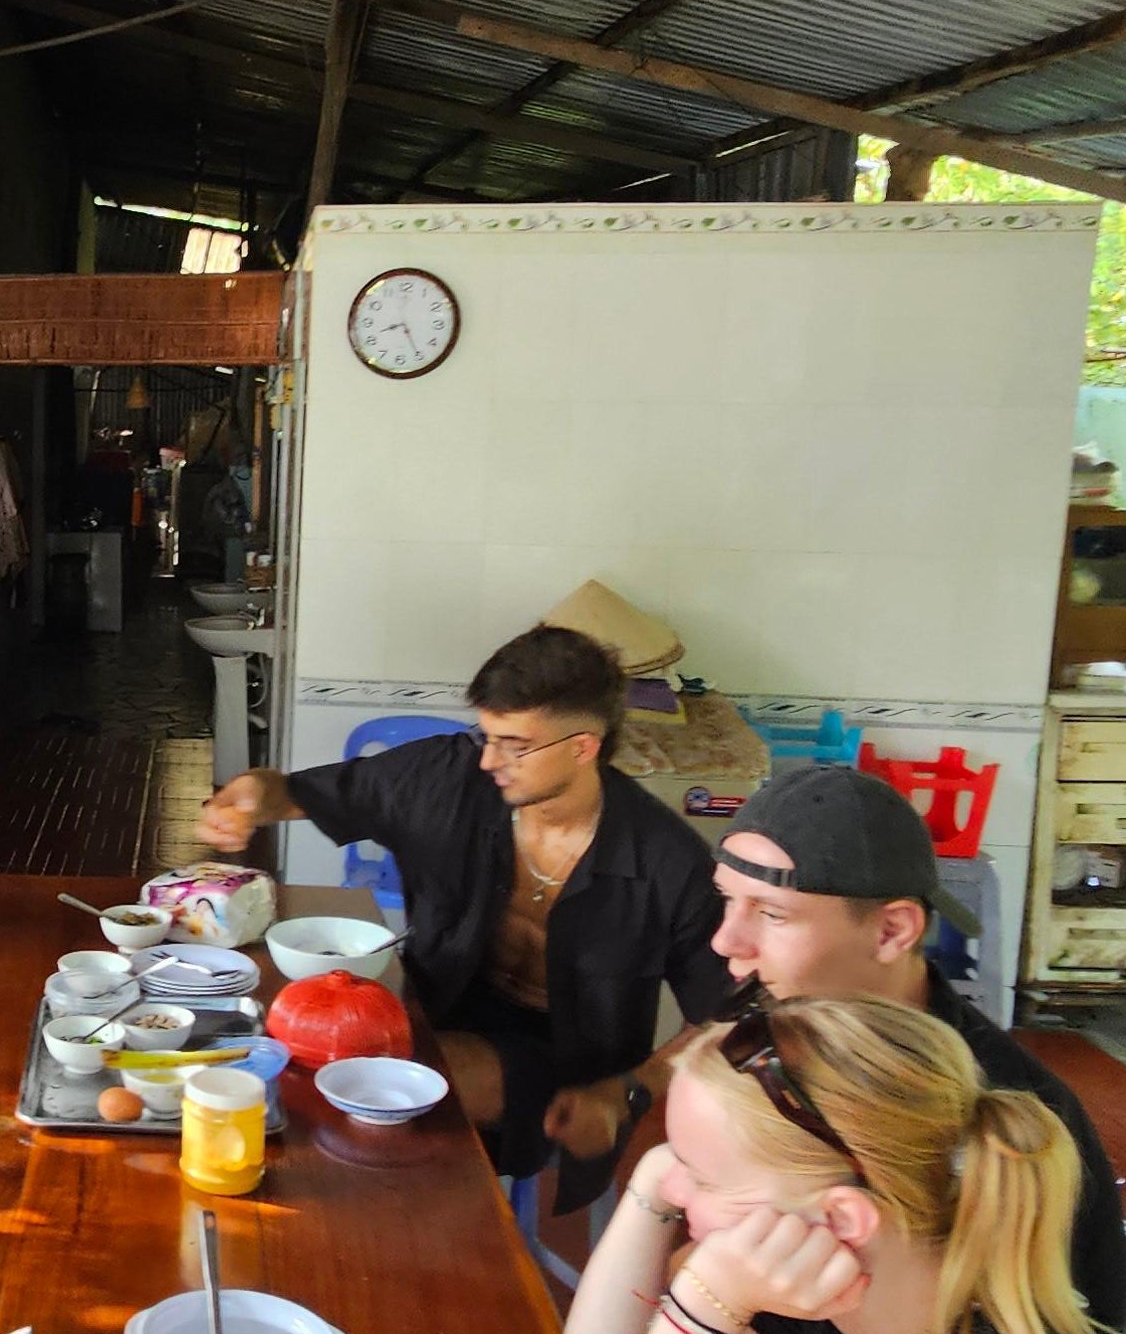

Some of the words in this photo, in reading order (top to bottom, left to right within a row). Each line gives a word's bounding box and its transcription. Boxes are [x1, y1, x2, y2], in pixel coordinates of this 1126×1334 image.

[433, 320, 445, 330] 3
[379, 350, 388, 359] 7
[414, 351, 424, 361] 5
[395, 355, 406, 365] 6
